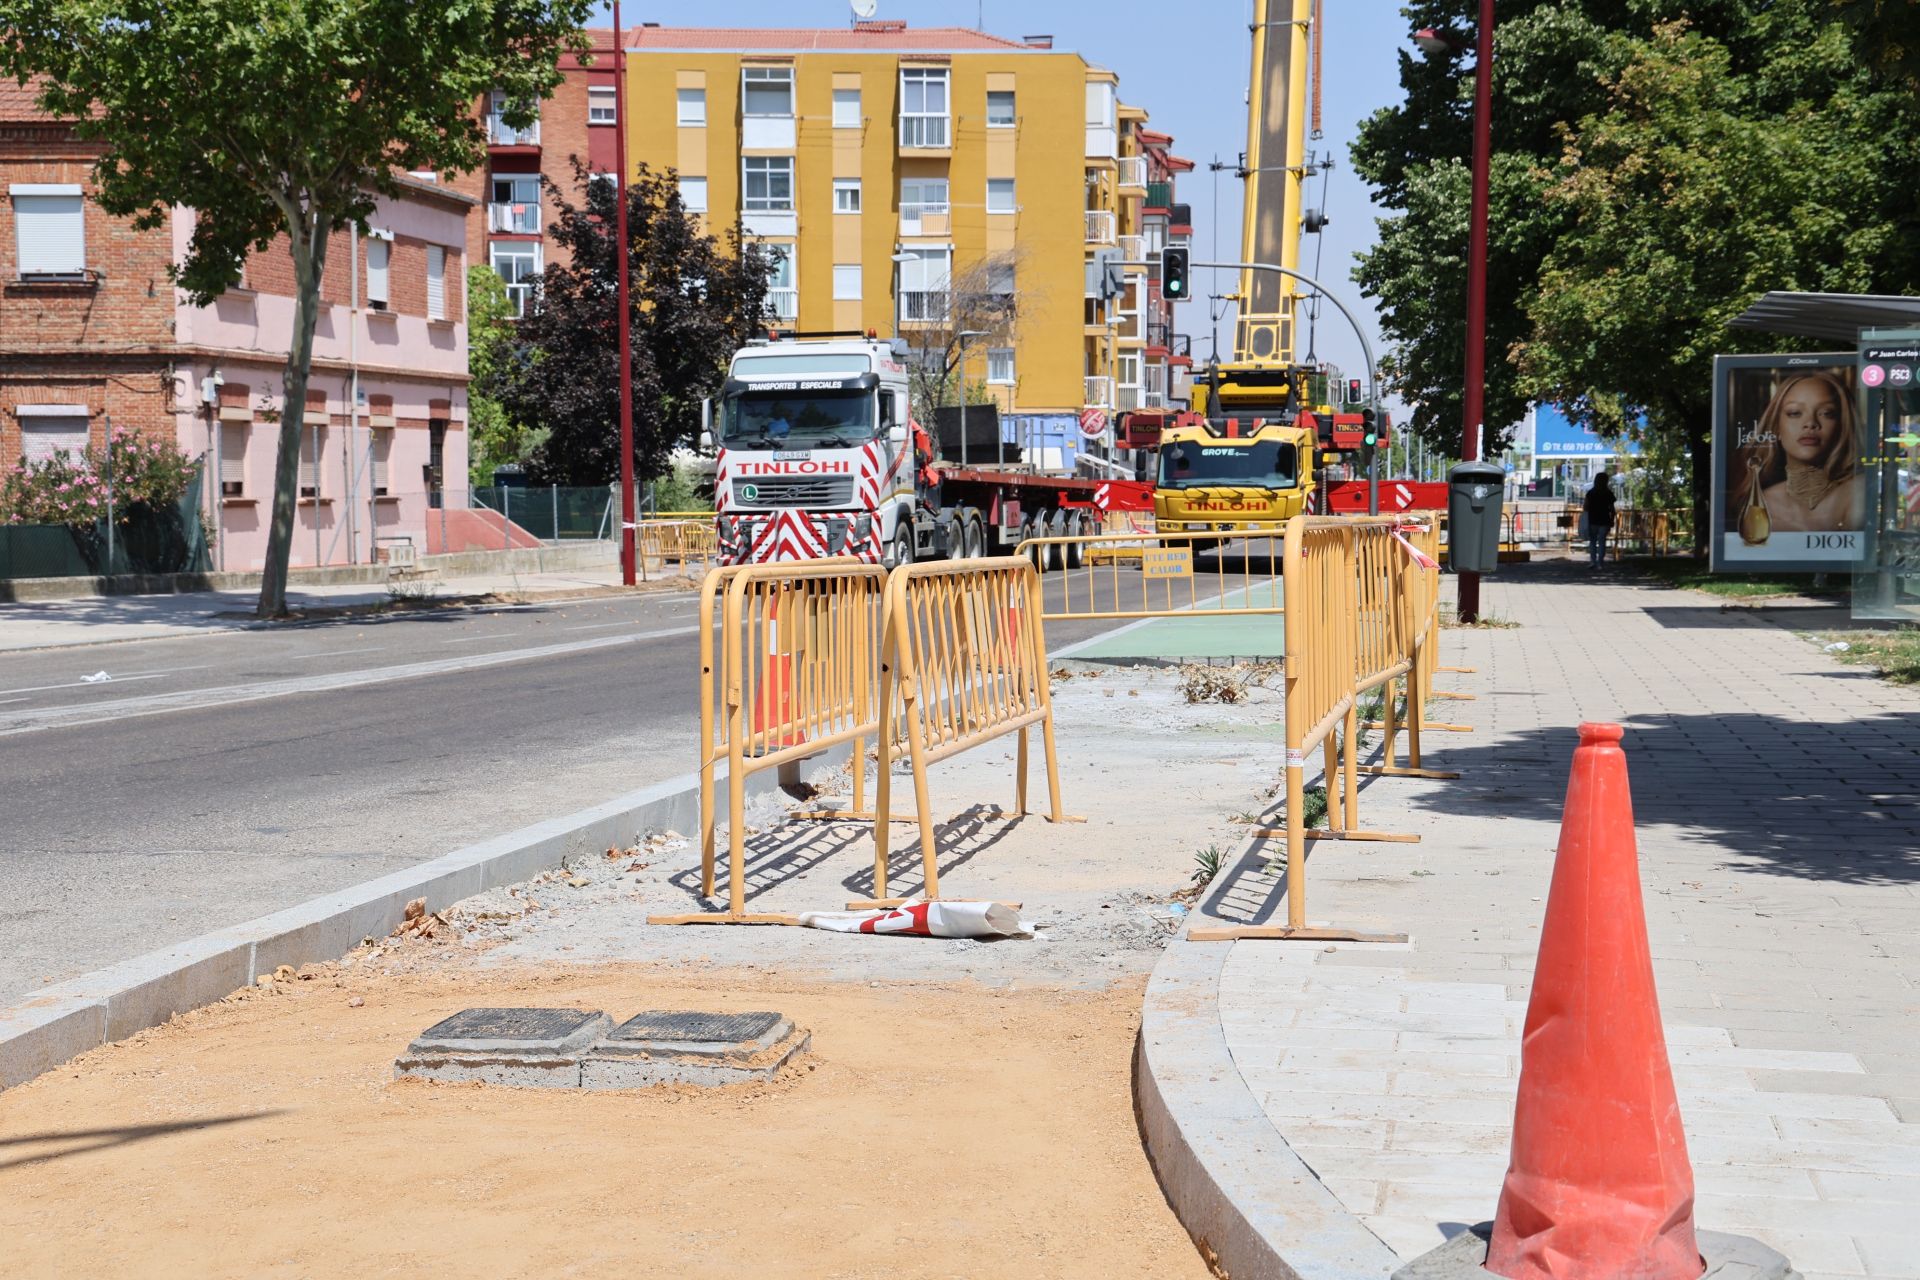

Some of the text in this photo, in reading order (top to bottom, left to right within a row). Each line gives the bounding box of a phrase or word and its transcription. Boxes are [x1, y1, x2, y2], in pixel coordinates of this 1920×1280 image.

[1868, 370, 1878, 382] 3
[1890, 369, 1910, 380] PSC3
[748, 381, 842, 391] TRANSPORTES ESPECIALES
[1201, 448, 1235, 456] GROVE
[736, 461, 849, 474] TINLOHI
[746, 487, 753, 498] L
[1184, 501, 1267, 511] TINLOHI
[1805, 534, 1856, 549] DIOR
[1167, 553, 1187, 561] RED
[1150, 564, 1183, 574] CALOR
